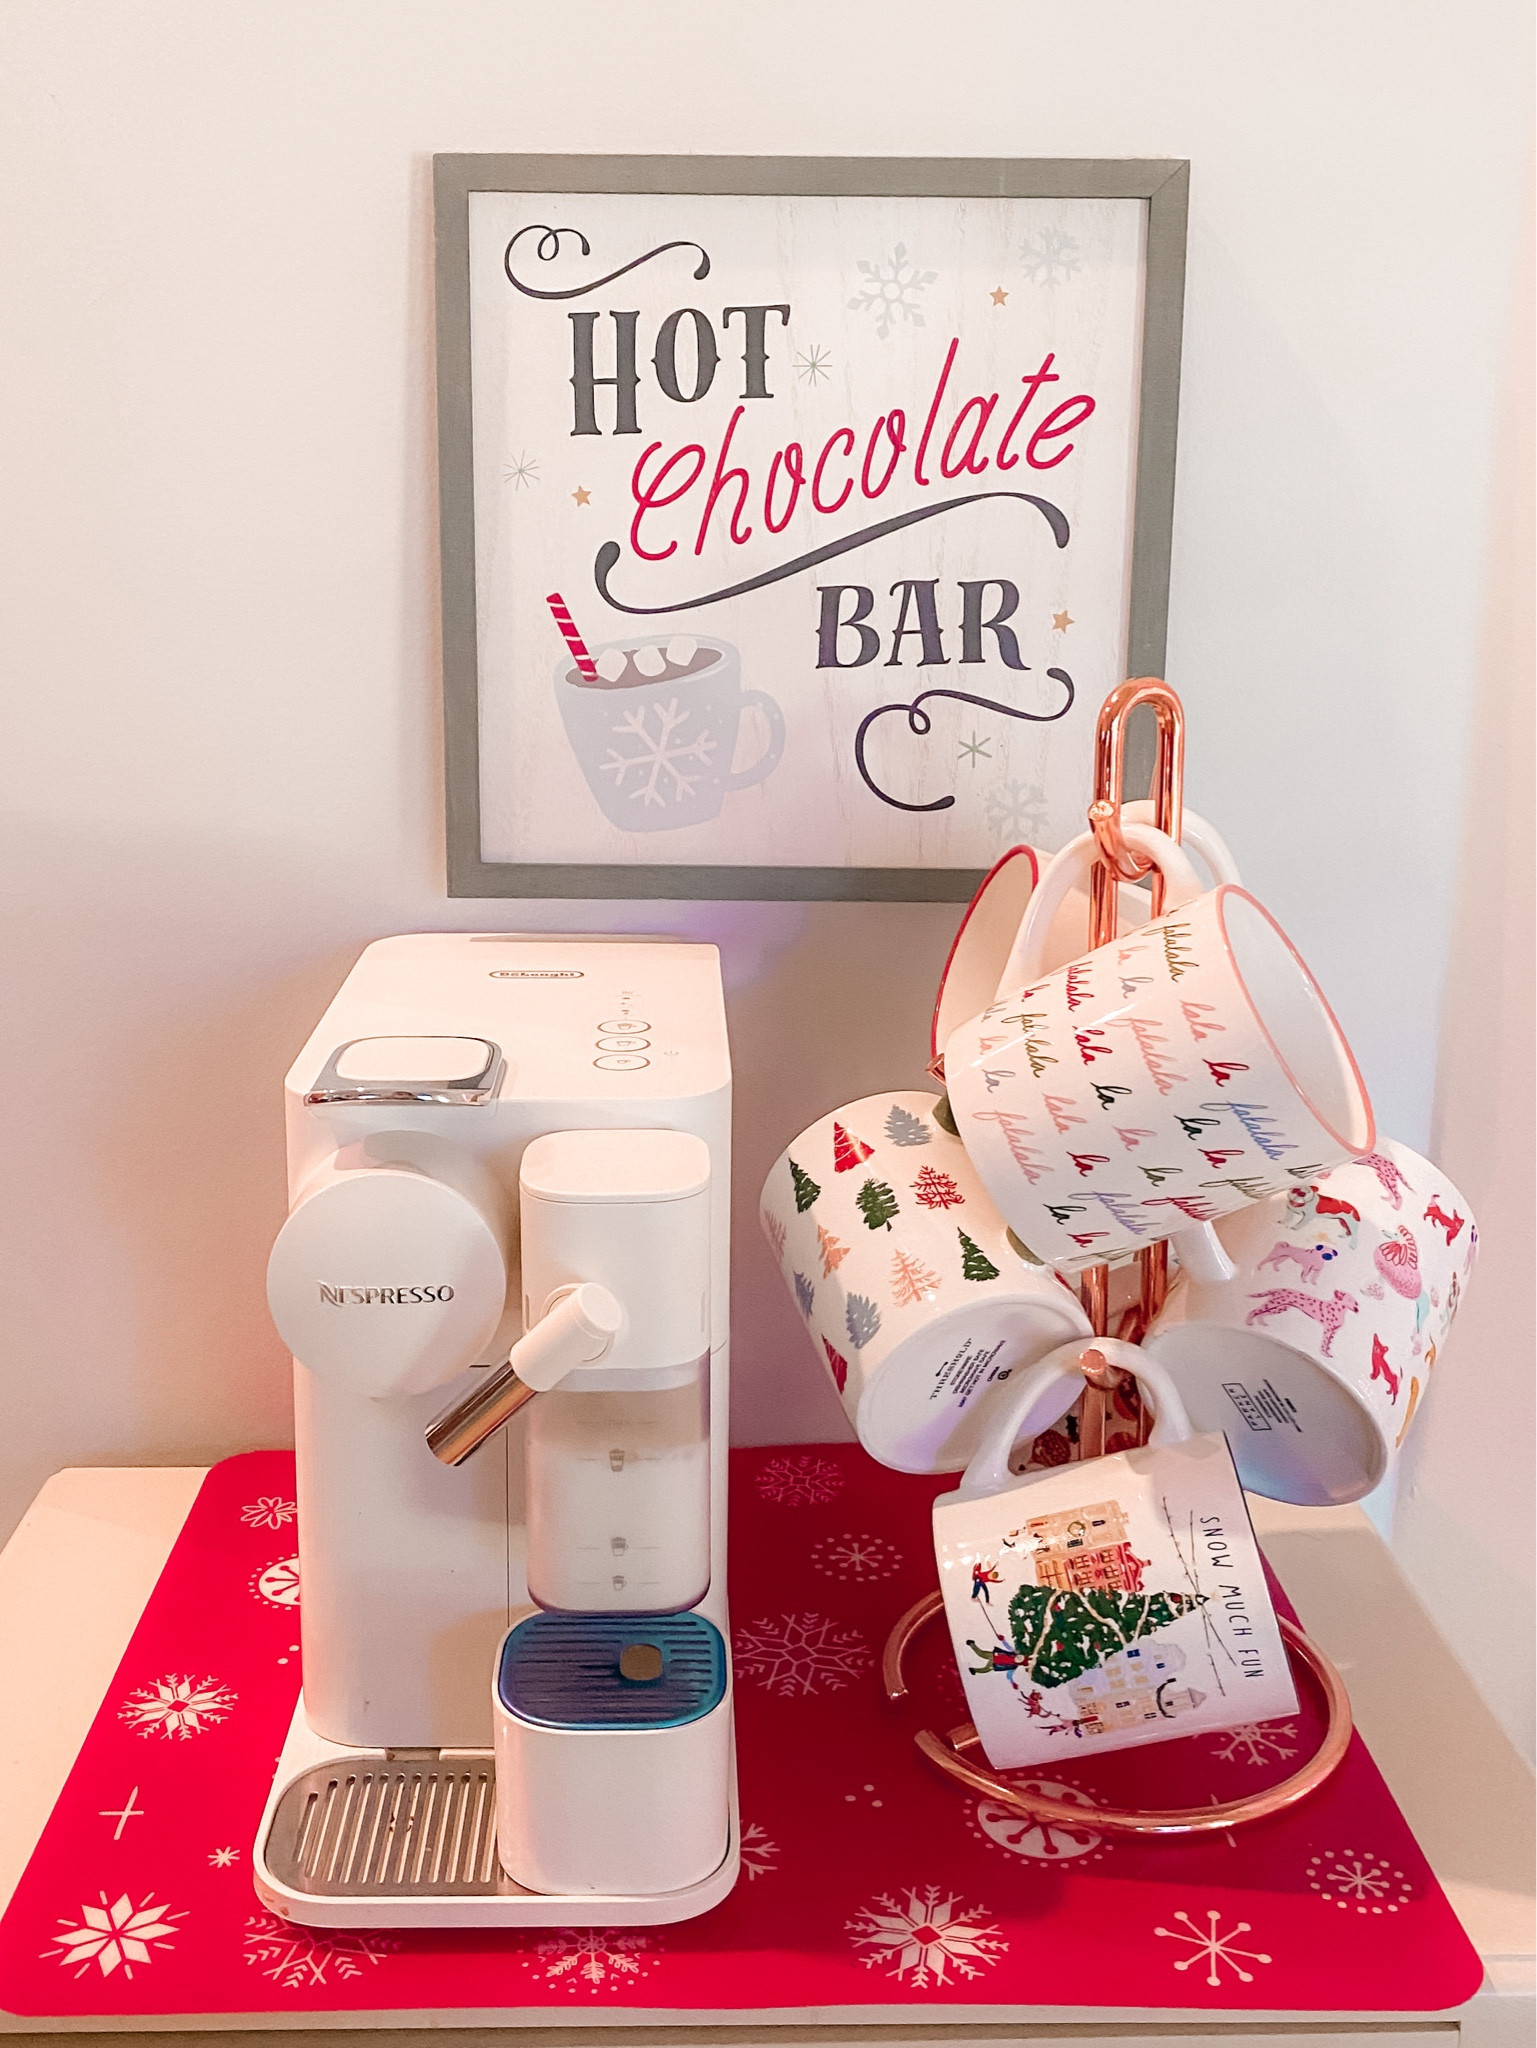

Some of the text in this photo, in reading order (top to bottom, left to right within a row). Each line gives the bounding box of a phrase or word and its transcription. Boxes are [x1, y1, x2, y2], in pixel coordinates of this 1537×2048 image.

[568, 304, 791, 437] HOT
[630, 337, 1096, 561] Chocolate
[815, 578, 1031, 671] BAR
[1119, 977, 1154, 999] la
[1179, 1000, 1226, 1042] lala
[982, 1068, 1016, 1093] la
[1202, 1058, 1249, 1087] la
[1090, 1082, 1132, 1111] la
[1042, 1093, 1088, 1135] lala
[1174, 1115, 1220, 1140] la
[1112, 1125, 1157, 1152] la
[1066, 1151, 1110, 1177] la
[1197, 1148, 1244, 1169] la
[1137, 1165, 1183, 1187] la
[1043, 1203, 1087, 1225] la
[1067, 1232, 1110, 1248] la
[317, 1280, 455, 1307] NESPRESSO
[1200, 1516, 1264, 1678] SNOW MUCH FUN
